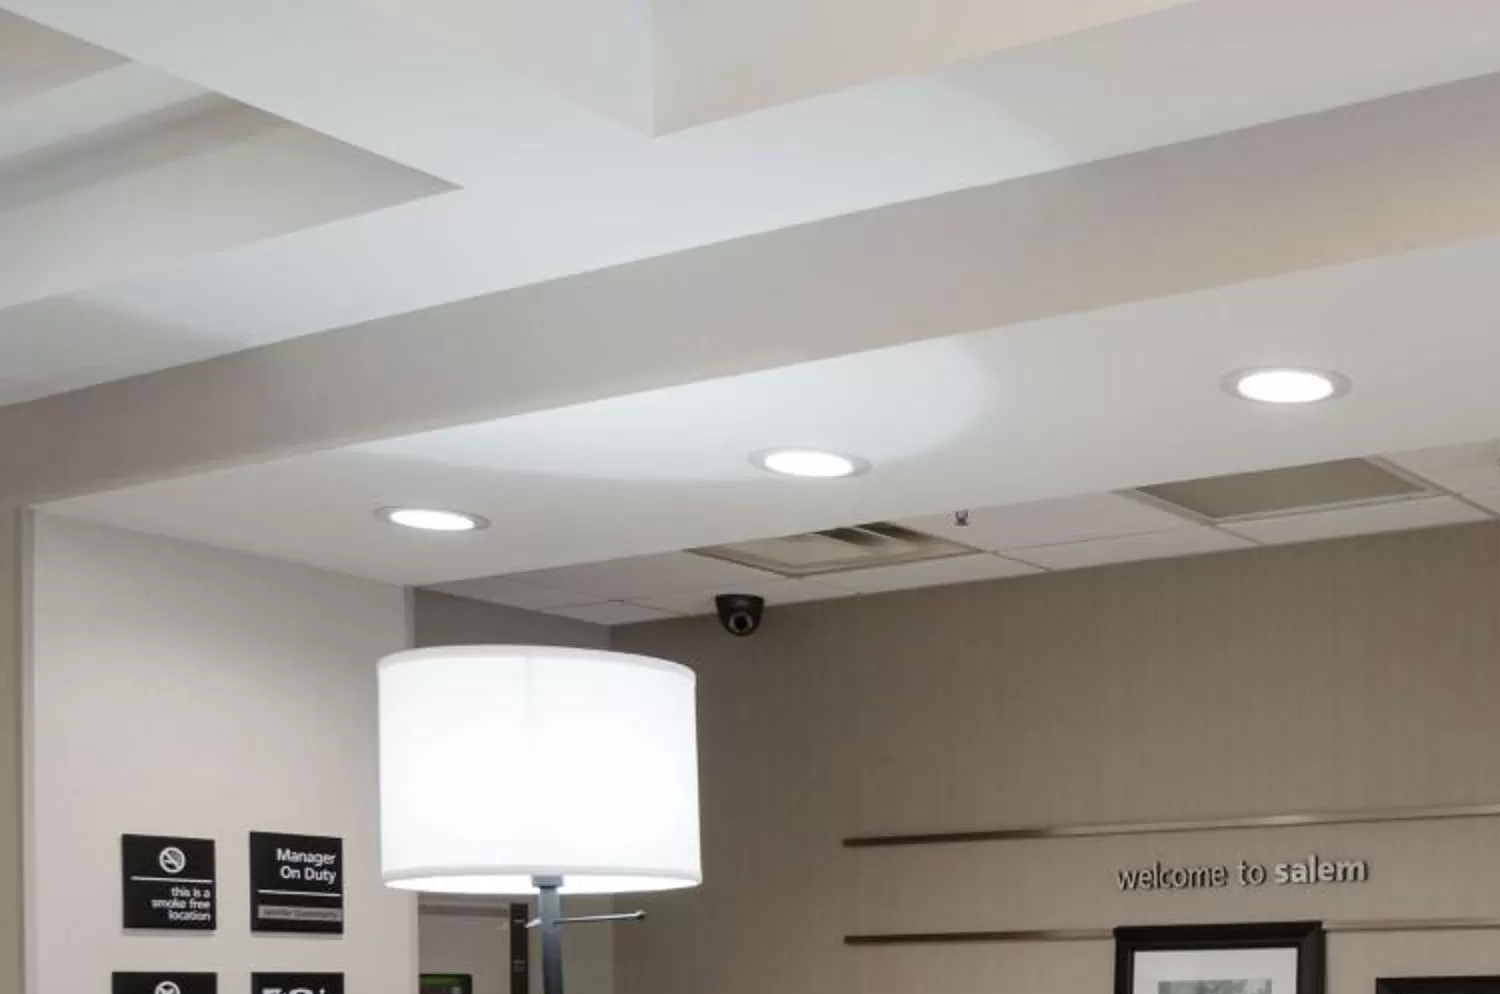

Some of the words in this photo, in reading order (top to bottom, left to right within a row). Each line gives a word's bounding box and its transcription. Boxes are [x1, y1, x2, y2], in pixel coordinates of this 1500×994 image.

[276, 847, 336, 867] Manager
[279, 865, 301, 879] On
[303, 867, 336, 885] Duty
[1117, 861, 1229, 891] welcome
[1237, 859, 1267, 886] to
[1274, 853, 1368, 885] salem
[170, 886, 191, 897] this
[192, 888, 201, 898] is
[203, 889, 212, 899] a
[151, 898, 187, 909] smoke
[189, 898, 211, 909] free
[167, 909, 212, 921] location
